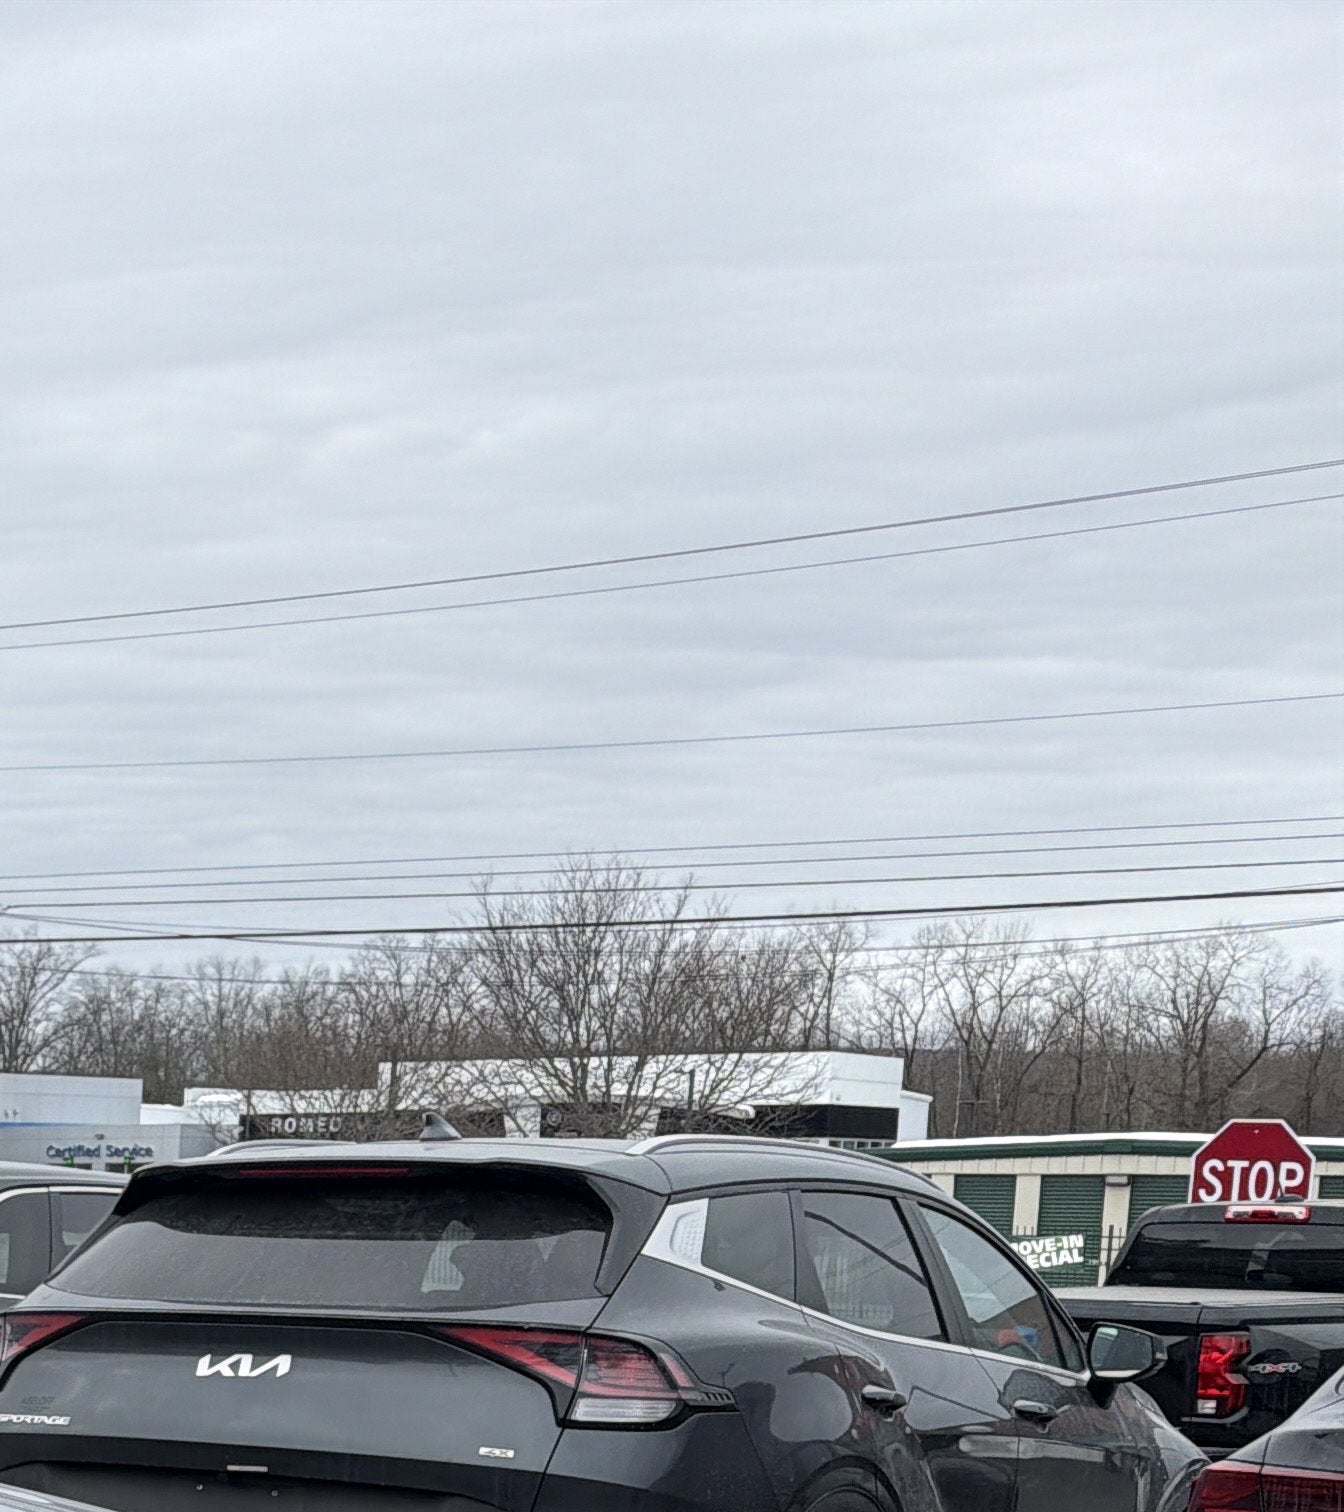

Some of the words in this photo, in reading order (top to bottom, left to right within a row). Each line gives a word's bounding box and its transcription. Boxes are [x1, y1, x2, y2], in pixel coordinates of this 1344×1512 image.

[270, 1117, 341, 1133] ROMEO
[46, 1144, 101, 1159] Certified
[105, 1144, 154, 1160] Service
[1198, 1158, 1305, 1202] STOP
[1024, 1248, 1084, 1269] ECIAL
[195, 1353, 292, 1378] KIA
